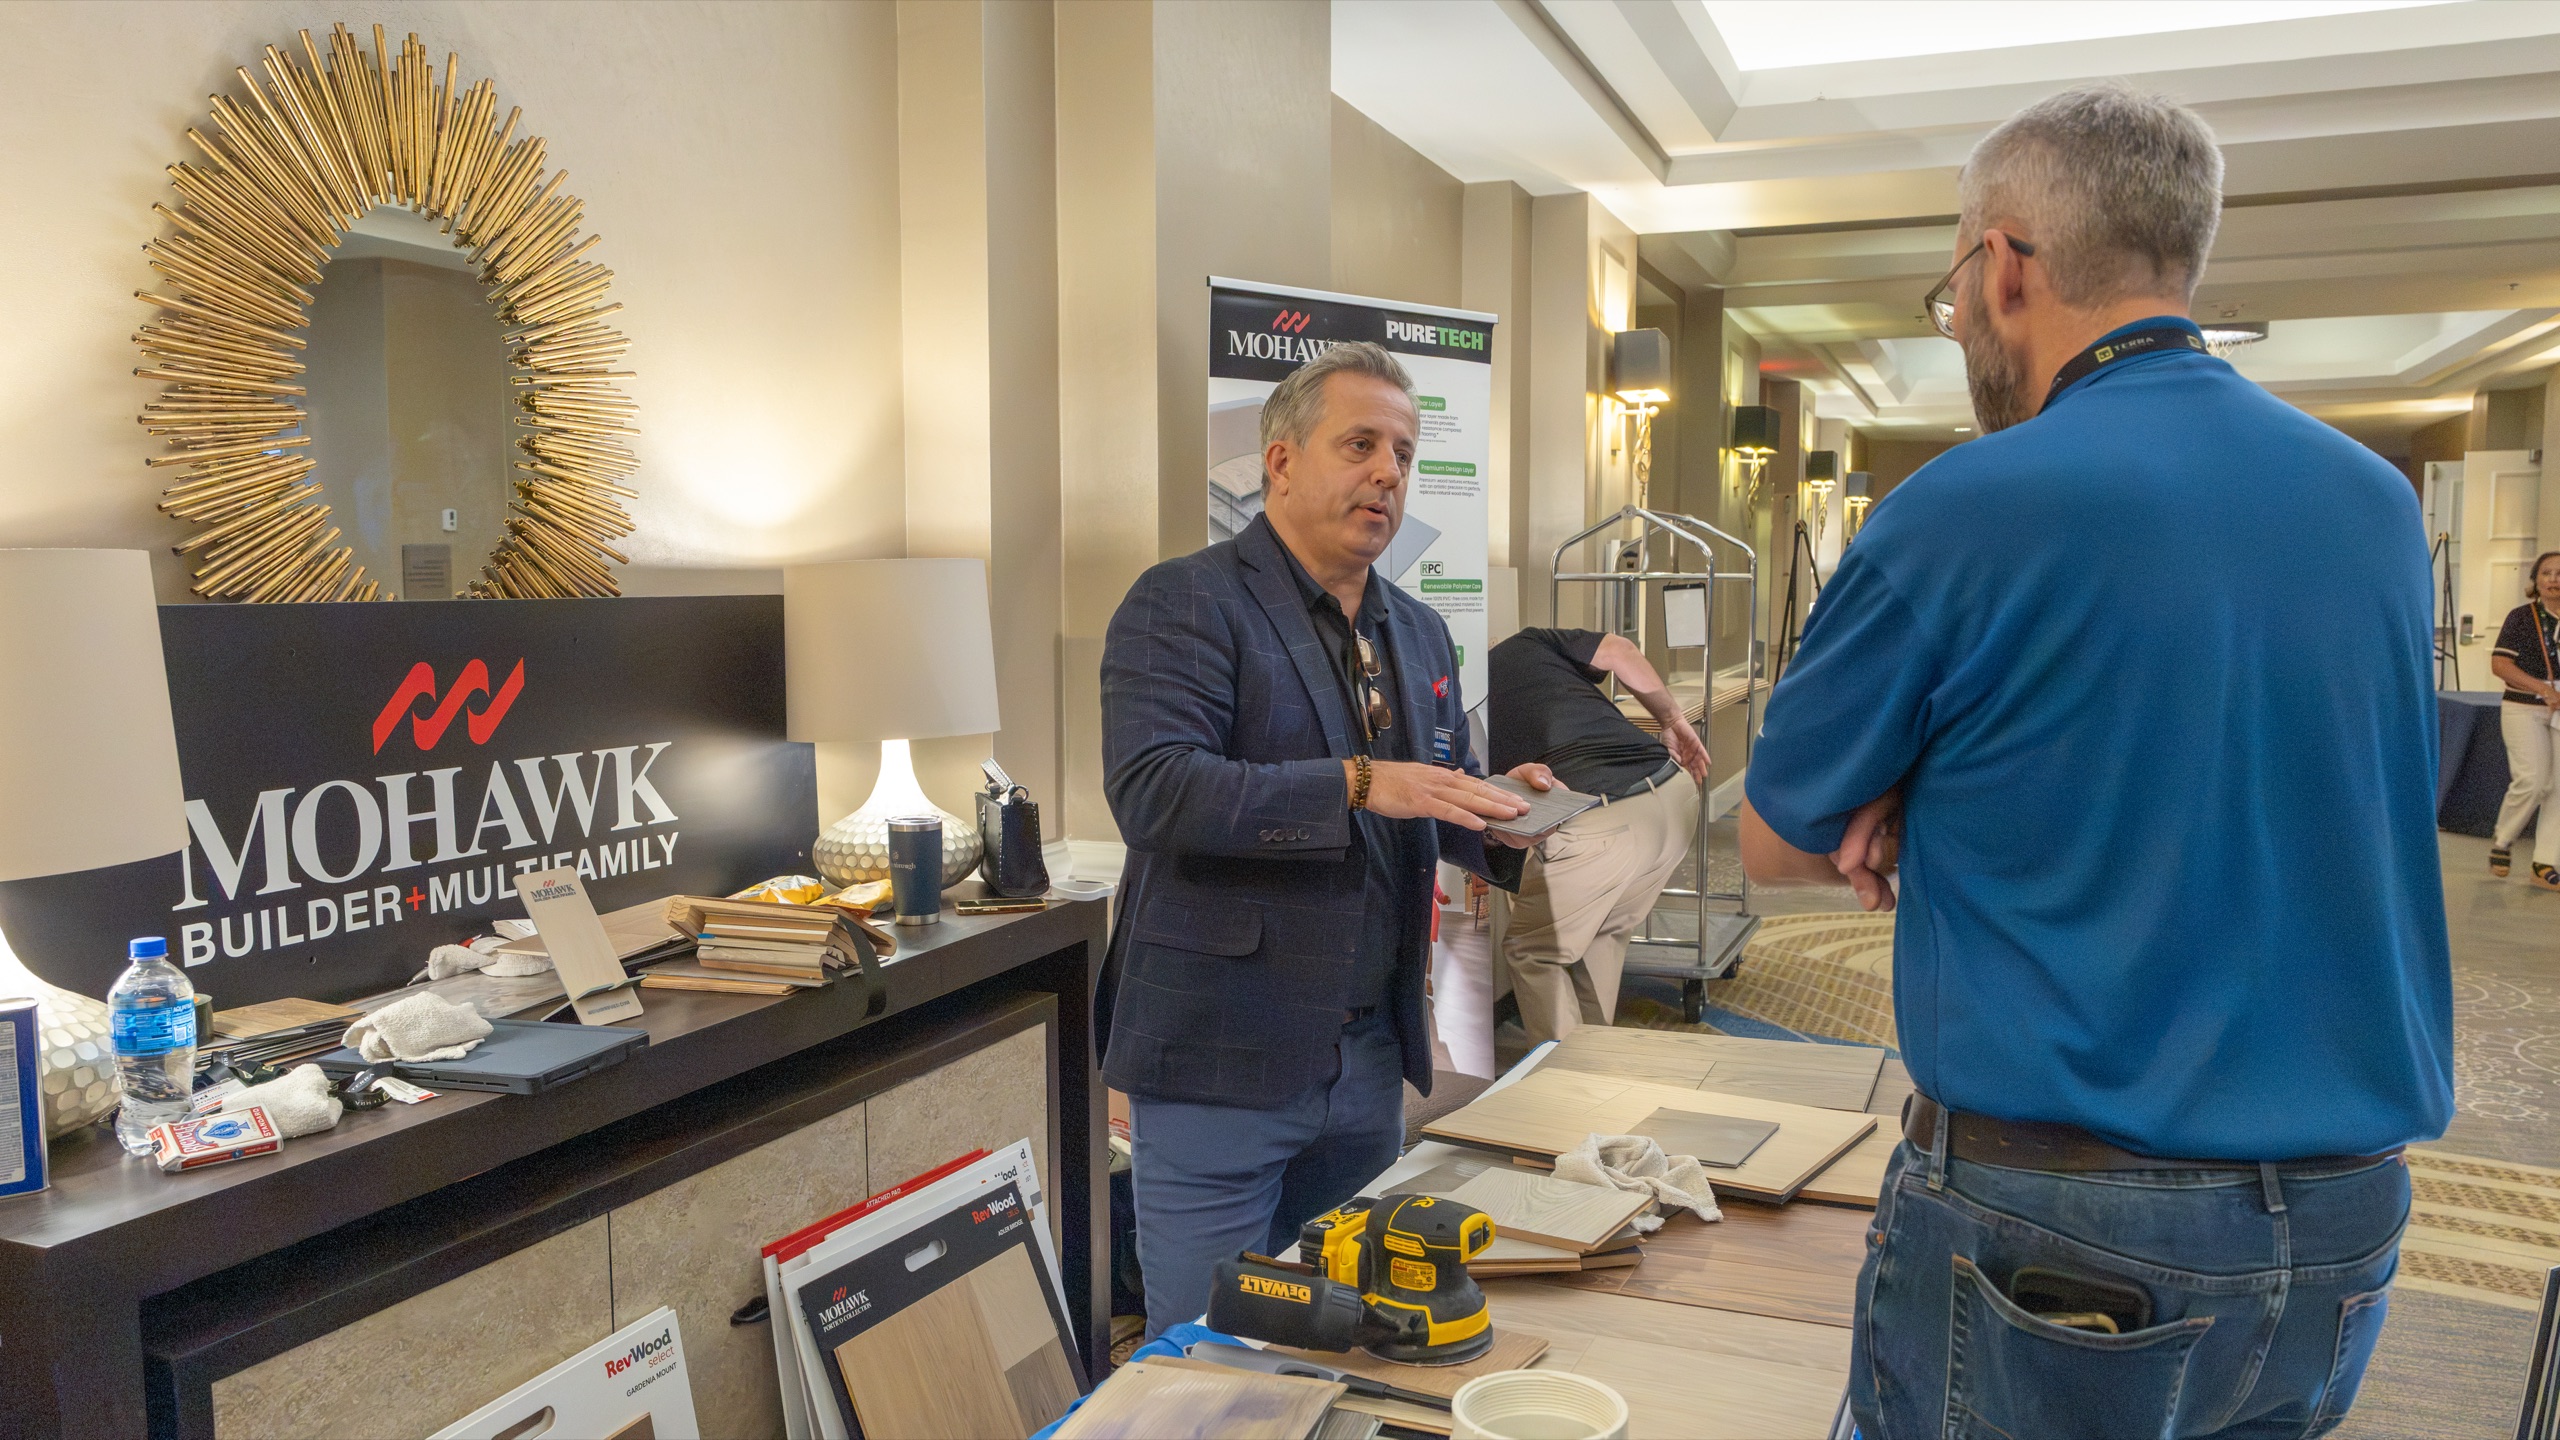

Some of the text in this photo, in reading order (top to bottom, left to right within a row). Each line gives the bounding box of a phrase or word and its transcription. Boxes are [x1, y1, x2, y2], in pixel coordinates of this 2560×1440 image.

[1228, 329, 1338, 363] MOHAW
[1386, 319, 1484, 351] PURETECH
[2114, 336, 2155, 351] TERRA
[1446, 465, 1462, 474] Design
[1463, 466, 1474, 474] Layer
[1421, 563, 1441, 574] RPC
[1453, 583, 1472, 591] Polymer
[171, 741, 678, 911] MOHAWK
[530, 883, 575, 900] MOHAWK
[252, 1108, 271, 1138] STANDARD
[866, 1187, 901, 1208] ATTACHED PAD
[971, 1192, 1016, 1225] RevWood
[1009, 1218, 1024, 1231] BRIDGE
[818, 1288, 869, 1326] MOHAWK
[823, 1302, 872, 1333] PORTICO COLLECTION
[604, 1328, 672, 1378] RevWood
[648, 1345, 675, 1369] select
[626, 1361, 677, 1398] GARDENIA MOUNT
